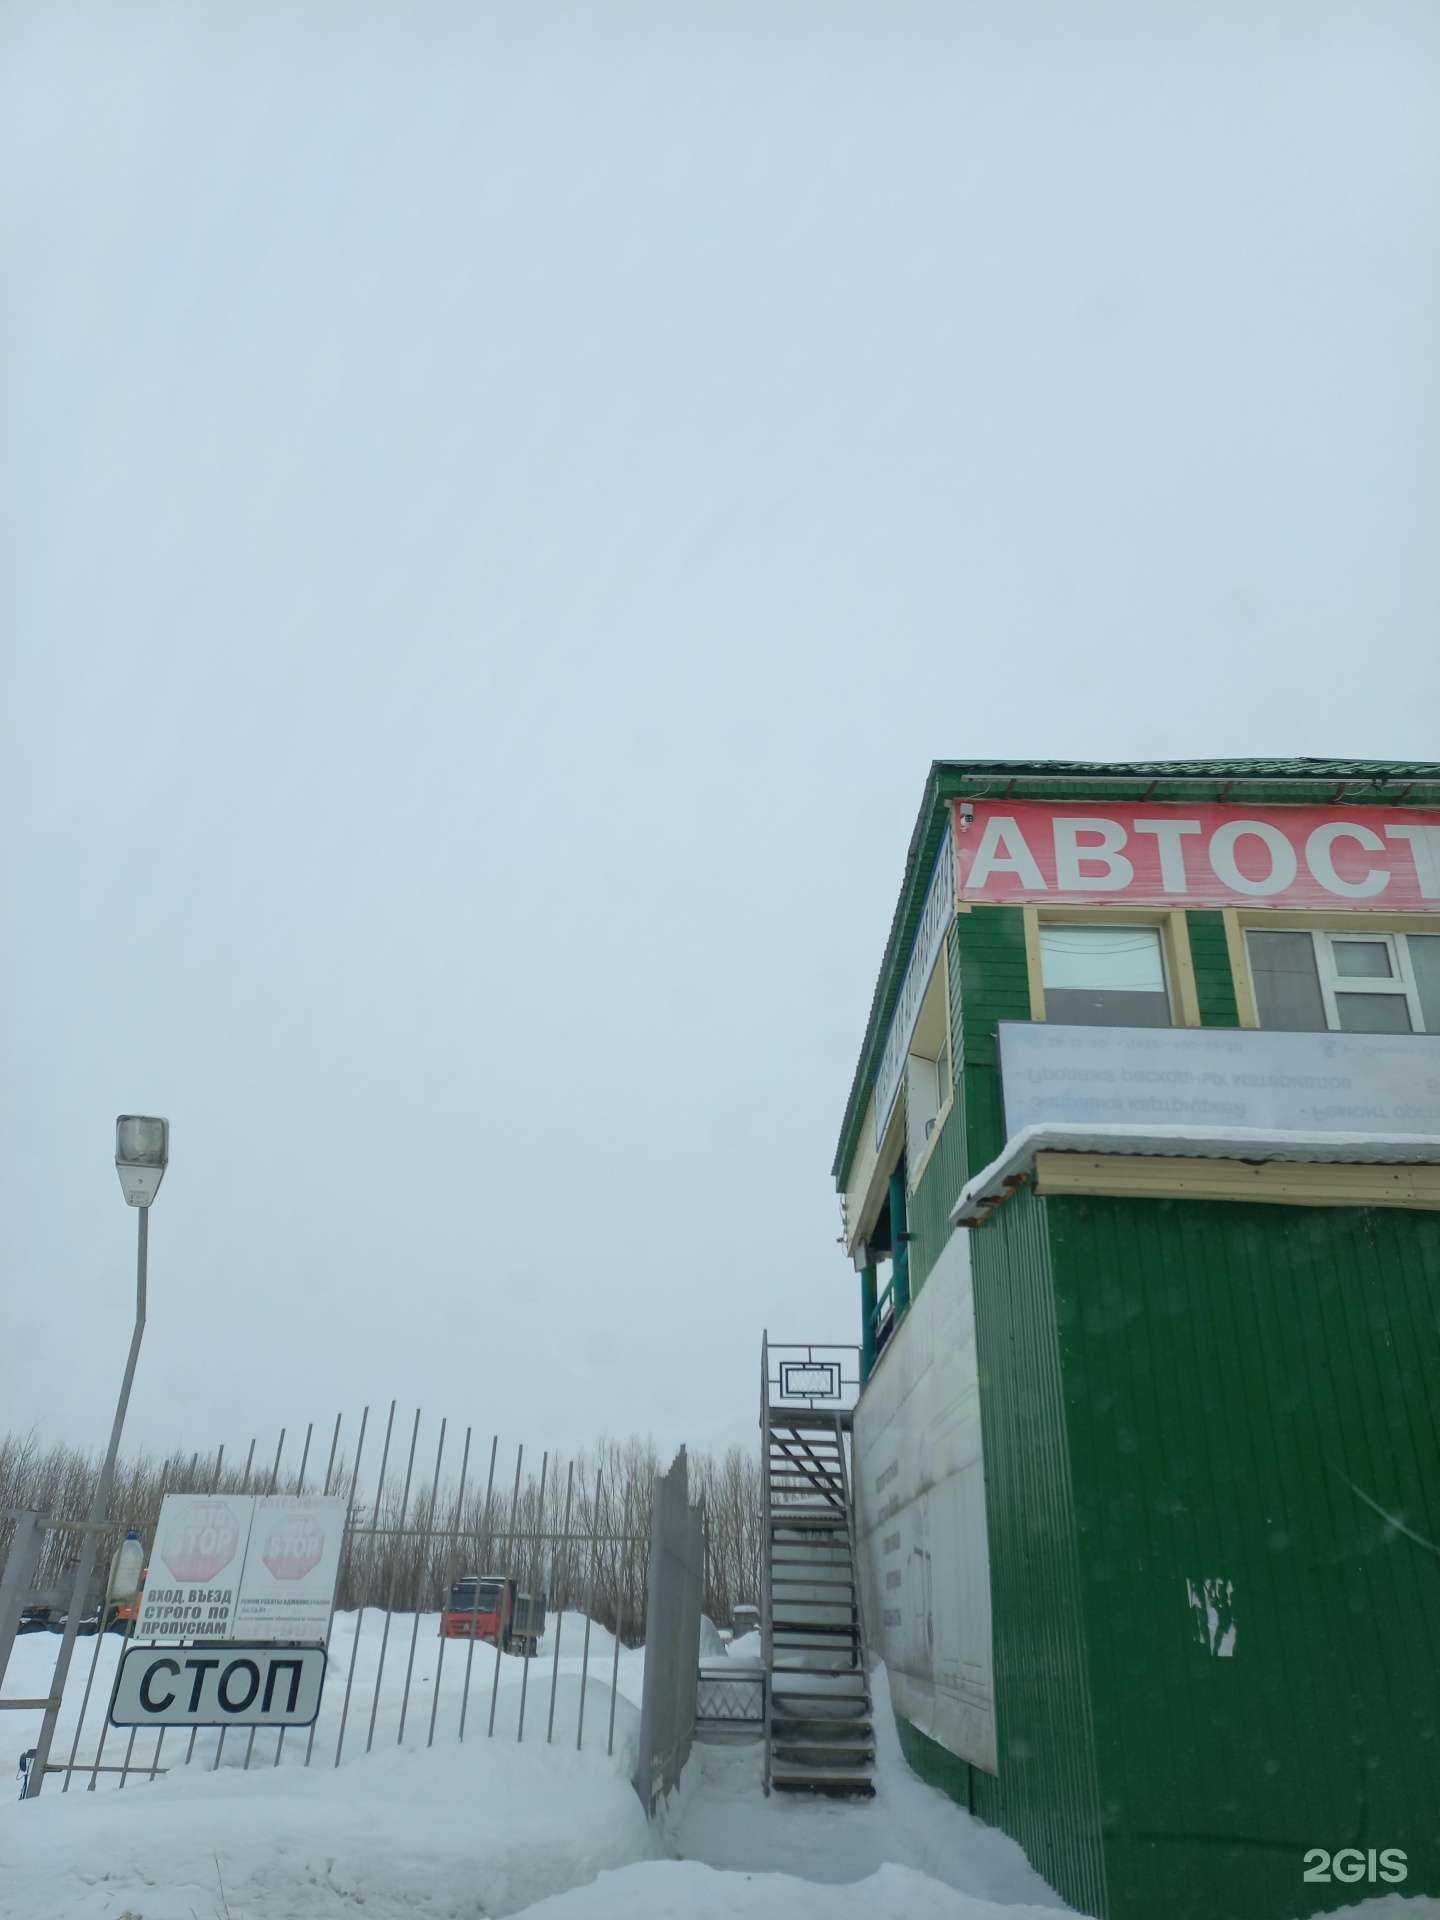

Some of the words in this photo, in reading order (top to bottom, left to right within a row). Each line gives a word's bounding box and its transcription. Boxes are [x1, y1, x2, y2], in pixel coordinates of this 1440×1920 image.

[188, 1590, 232, 1605] ВЪЕЗД
[144, 1606, 202, 1619] СТРОГО
[208, 1606, 229, 1619] ПО
[140, 1621, 227, 1635] ПРОПУСКАМ
[139, 1658, 303, 1713] СТОП
